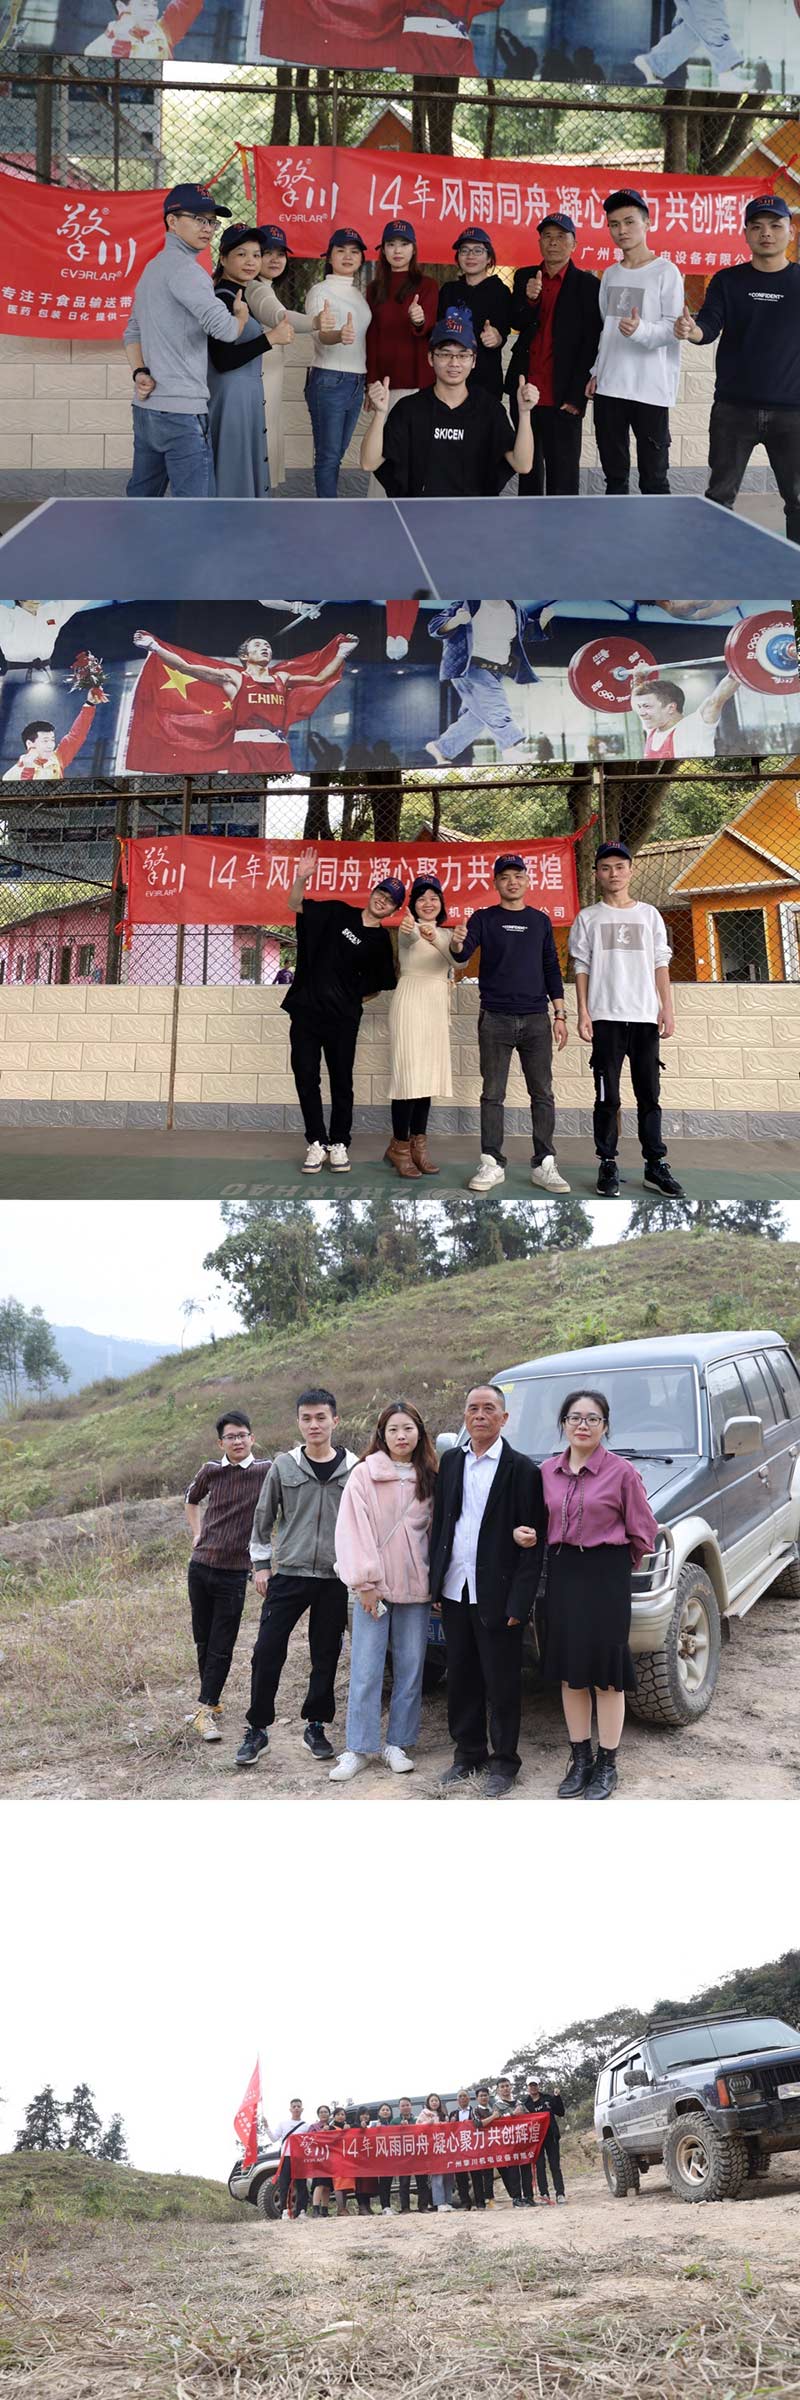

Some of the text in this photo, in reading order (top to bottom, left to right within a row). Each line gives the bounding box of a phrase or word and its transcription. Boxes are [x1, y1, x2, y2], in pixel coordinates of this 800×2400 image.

[7, 304, 32, 317] 医药
[38, 309, 62, 319] 包装
[68, 311, 89, 321] 日化
[248, 693, 285, 705] CHINA
